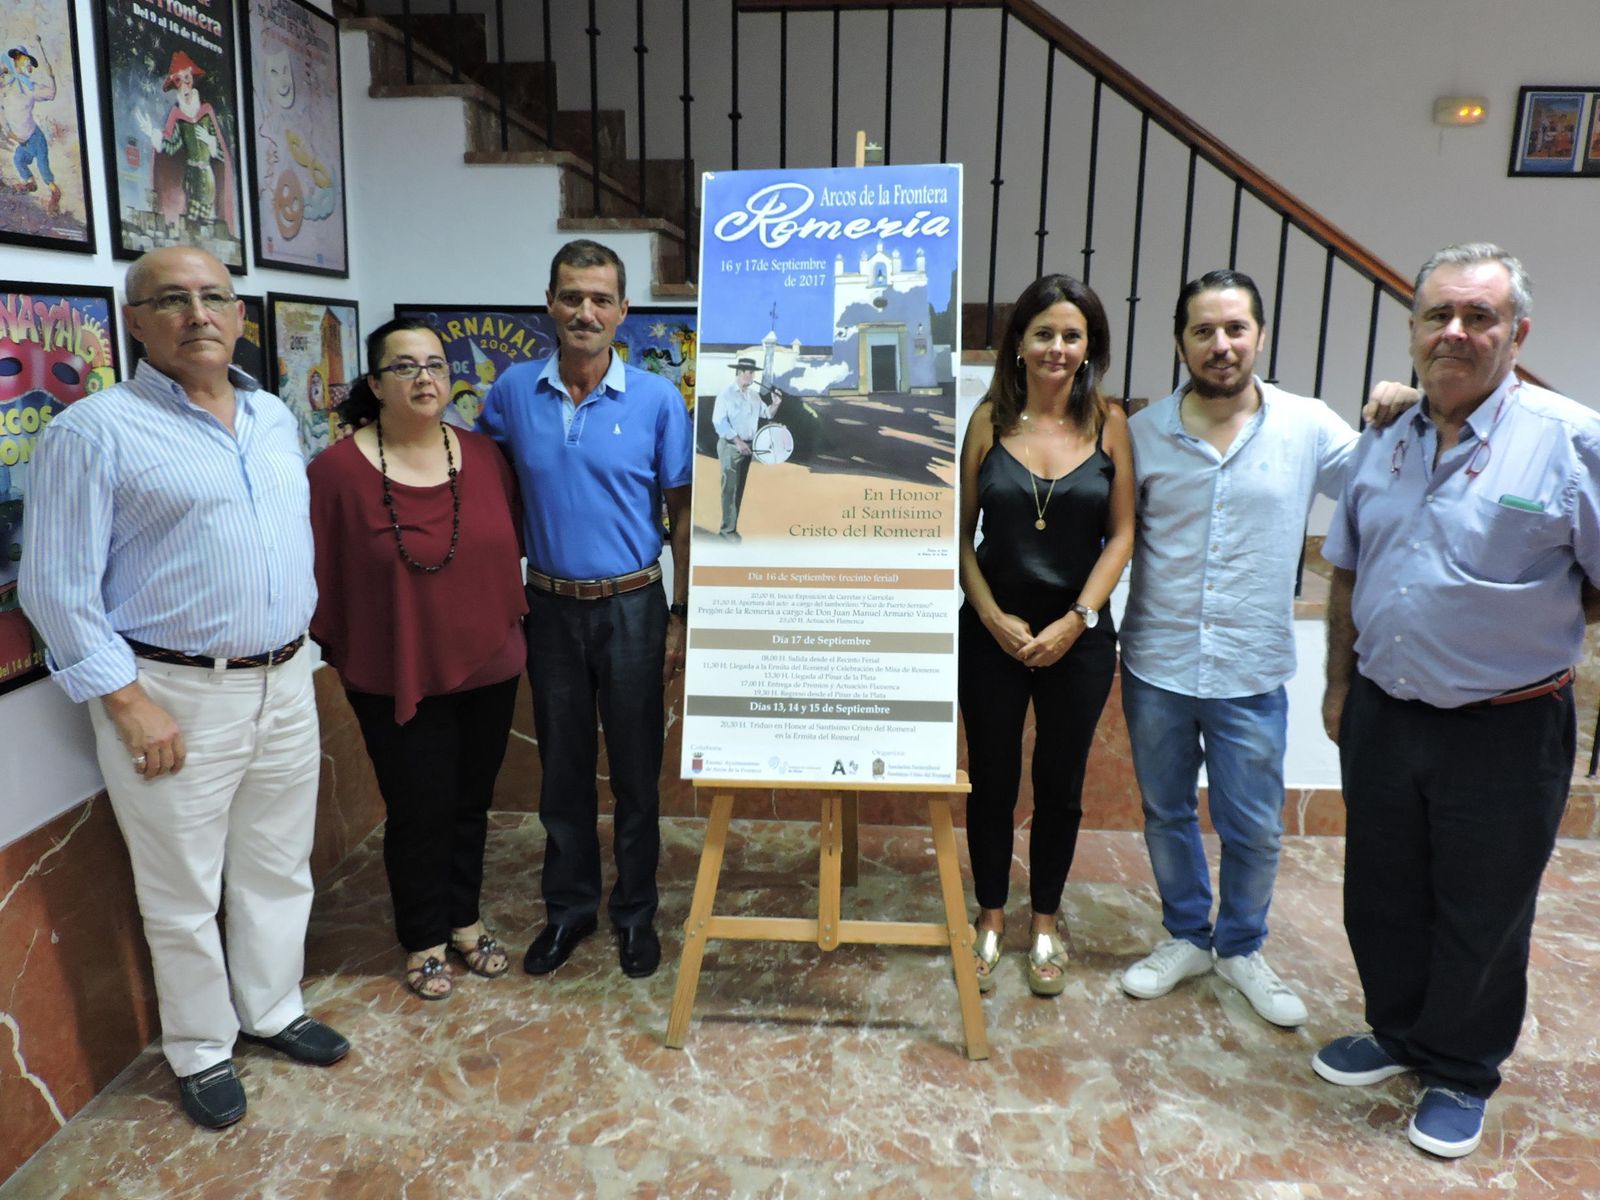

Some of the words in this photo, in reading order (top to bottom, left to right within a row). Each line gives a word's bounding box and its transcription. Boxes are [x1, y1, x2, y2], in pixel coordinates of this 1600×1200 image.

[133, 2, 149, 20] Del
[820, 186, 856, 206] Arcos
[860, 184, 874, 206] de
[878, 184, 890, 206] la
[894, 184, 948, 205] Frontera
[714, 182, 950, 248] Romería
[721, 260, 733, 272] 16
[735, 262, 742, 274] y
[771, 258, 826, 273] Septiembre
[784, 274, 797, 287] de
[800, 274, 826, 286] 2017
[480, 340, 518, 360] 2002
[452, 360, 470, 374] DE
[864, 488, 883, 501] En
[890, 488, 943, 501] Honor
[842, 506, 856, 519] al
[862, 506, 942, 520] Santísimo
[789, 524, 838, 537] Cristo
[842, 524, 867, 538] del
[874, 525, 942, 538] Romeral
[748, 572, 763, 581] Día
[766, 572, 777, 581] 16
[778, 572, 789, 582] de
[790, 572, 837, 584] Septiembre
[838, 574, 872, 584] (recinto
[874, 574, 900, 584] ferial)
[782, 609, 804, 618] cargo
[832, 609, 850, 618] Juan
[772, 634, 789, 644] Día
[792, 635, 802, 644] 17
[804, 635, 816, 645] de
[816, 636, 872, 647] Septiembre
[729, 663, 754, 671] Llegada
[750, 701, 772, 711] Días
[773, 702, 786, 712] 13,
[788, 703, 799, 712] 14
[800, 705, 807, 714] y
[810, 704, 820, 713] 15
[822, 704, 834, 713] de
[836, 704, 890, 716] Septiembre
